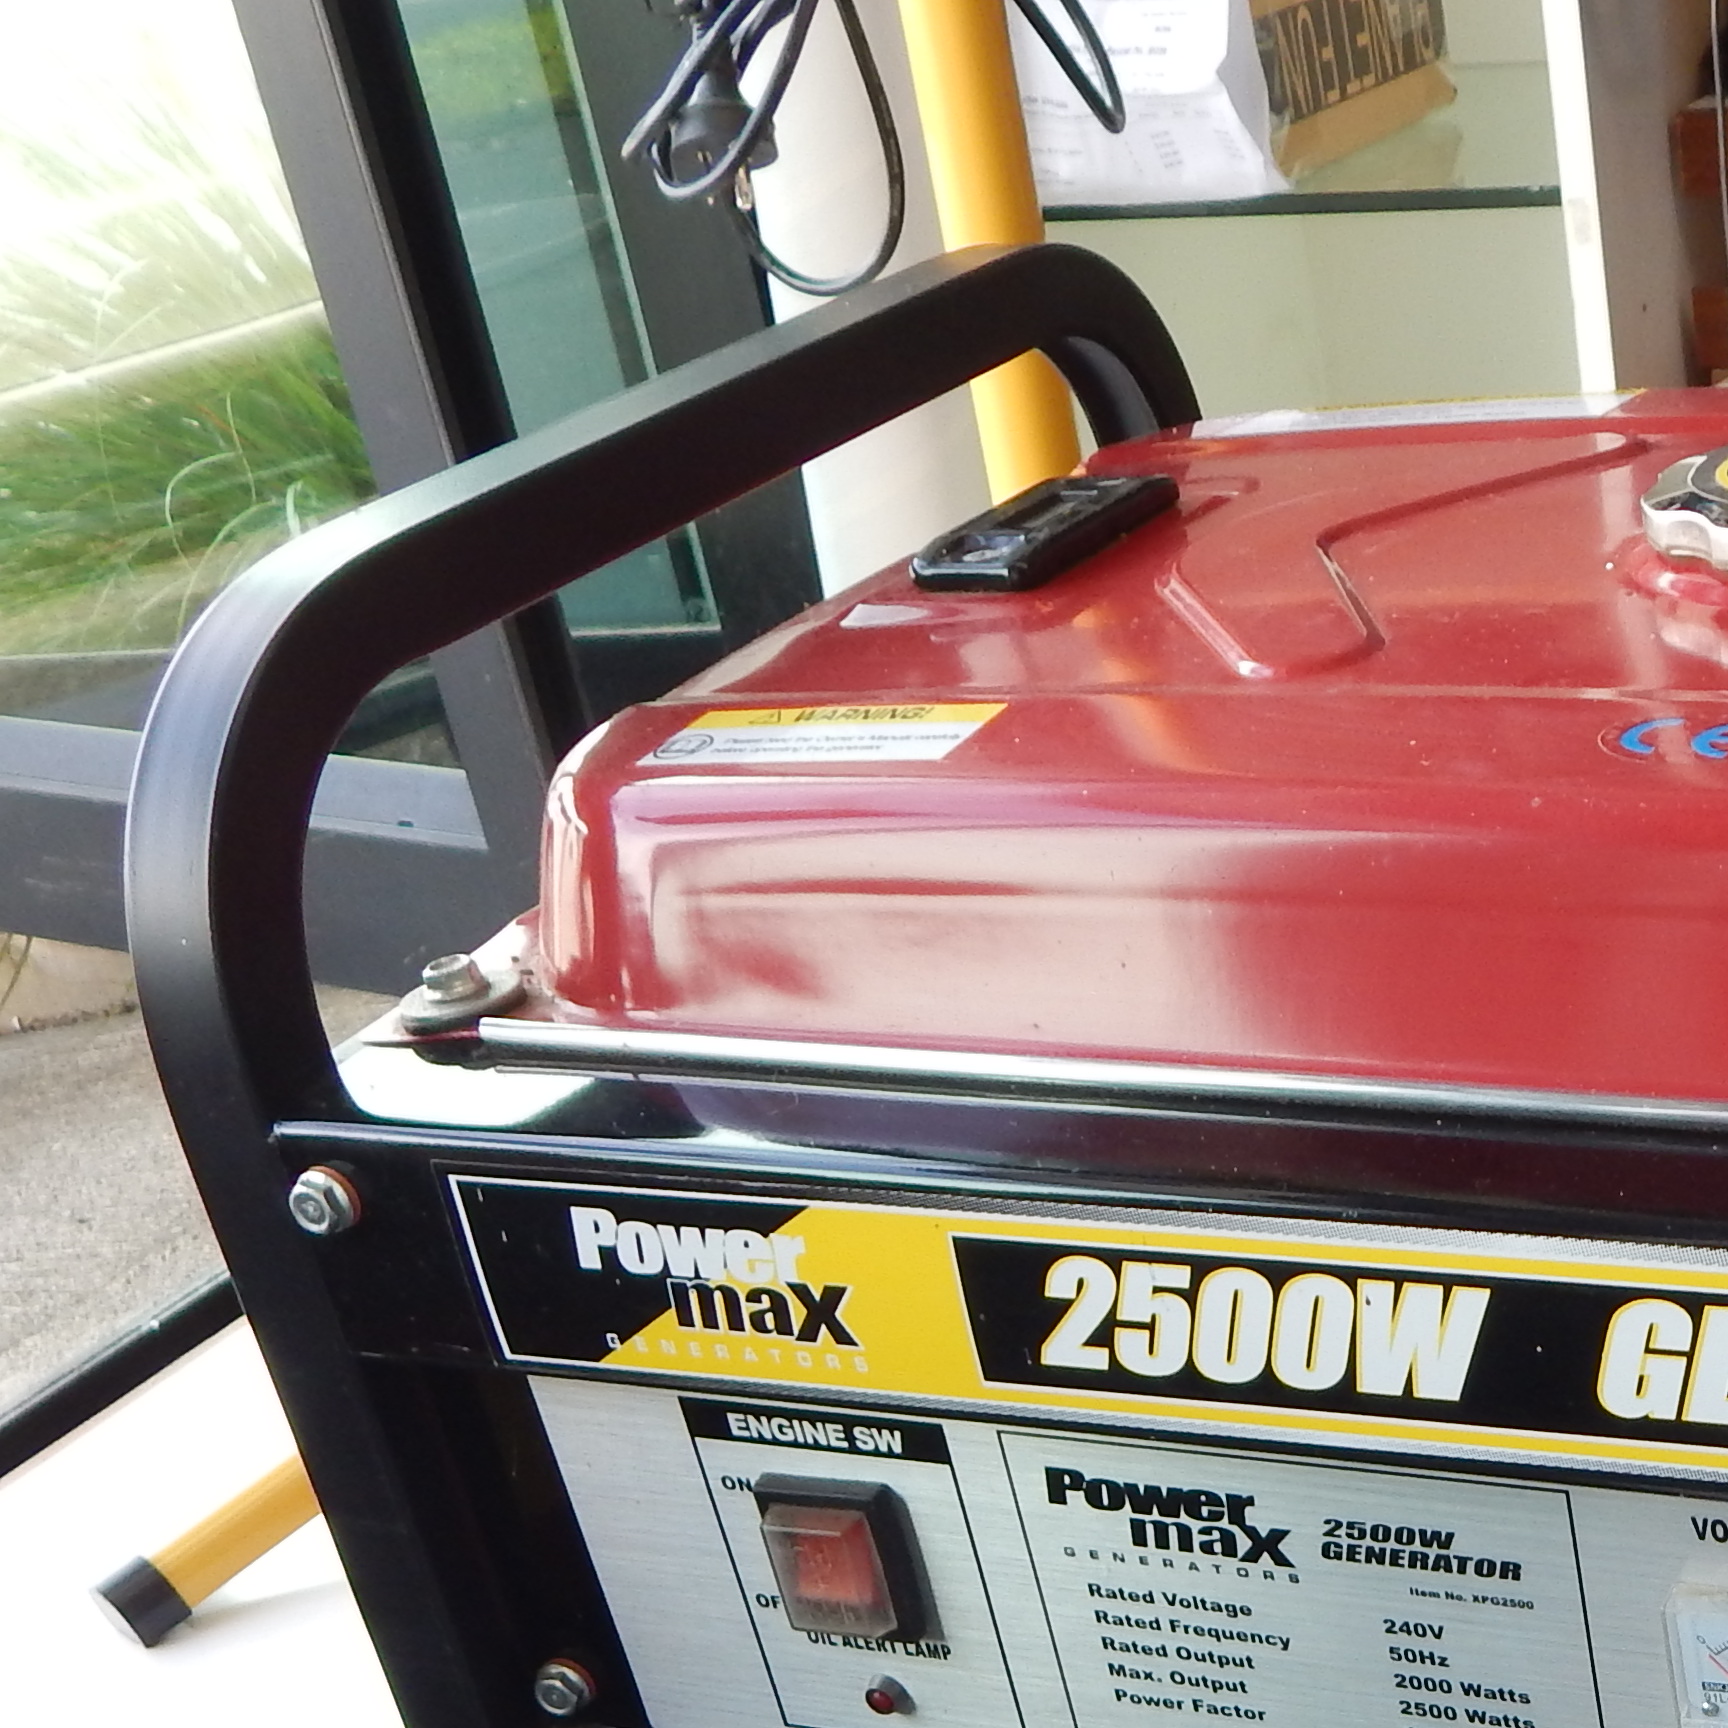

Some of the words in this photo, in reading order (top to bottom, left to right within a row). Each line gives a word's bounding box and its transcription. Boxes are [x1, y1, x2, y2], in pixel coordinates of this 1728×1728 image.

[794, 706, 935, 722] WARNING!
[569, 1205, 807, 1284] Power
[669, 1277, 865, 1350] max
[1041, 1254, 1491, 1401] 2500W
[605, 1333, 870, 1374] GENERATORS
[726, 1412, 849, 1449] ENGINE
[854, 1425, 903, 1455] SW
[721, 1475, 753, 1493] ON
[1044, 1466, 1256, 1526] Power
[1129, 1517, 1296, 1568] max
[1321, 1518, 1456, 1552] 2500W
[1063, 1546, 1300, 1584] GENERATORS
[1320, 1540, 1523, 1582] GENERATOR
[756, 1593, 781, 1610] OF
[1087, 1583, 1155, 1604] Rated
[1161, 1591, 1253, 1618] Voltage
[1409, 1586, 1441, 1600] Item
[1444, 1590, 1467, 1602] No.
[1472, 1594, 1535, 1611] XPG2500
[1094, 1609, 1162, 1631] Rated
[1168, 1619, 1291, 1651] Frequency
[1383, 1618, 1444, 1640] 240V
[902, 1641, 951, 1661] LAMP
[1101, 1636, 1168, 1658] Rated
[1176, 1645, 1255, 1669] Output
[1388, 1646, 1450, 1668] 50Hz
[1107, 1662, 1163, 1683] Max.
[1170, 1670, 1248, 1694] Output
[1393, 1673, 1453, 1694] 2000
[1459, 1681, 1531, 1705] Watts
[1114, 1688, 1185, 1711] Power
[1191, 1698, 1267, 1721] Factor
[1399, 1700, 1458, 1721] 2500
